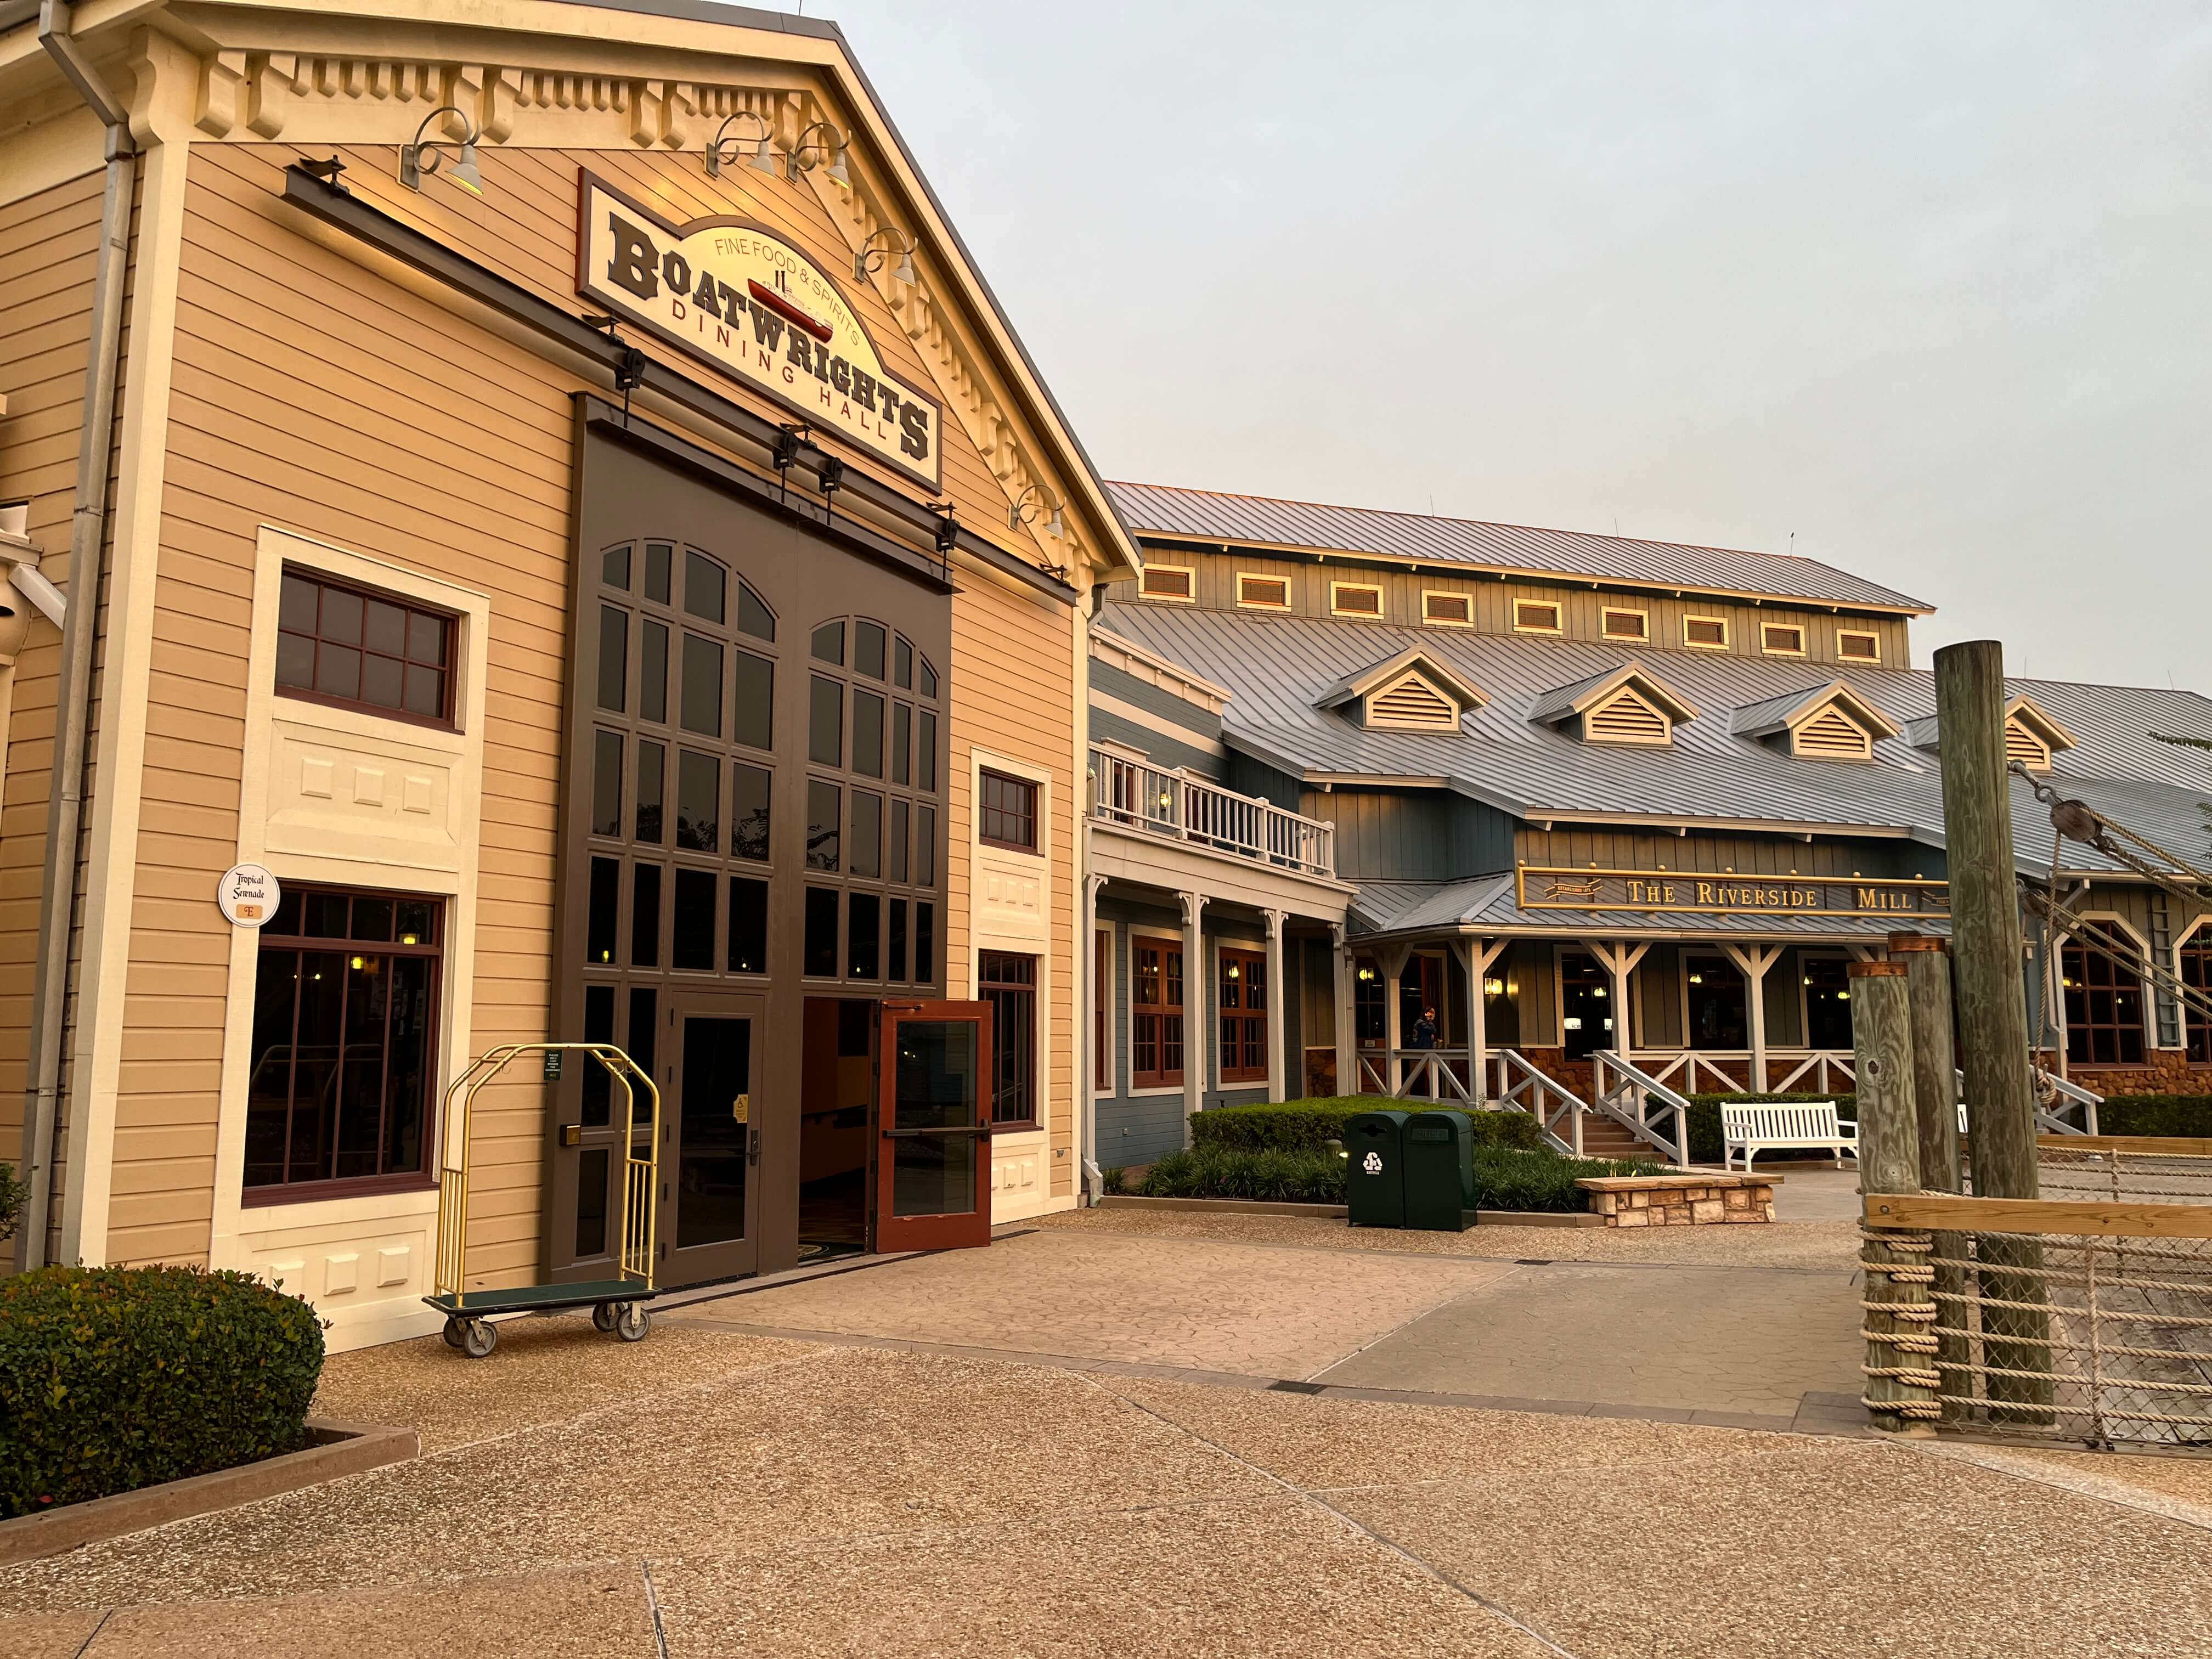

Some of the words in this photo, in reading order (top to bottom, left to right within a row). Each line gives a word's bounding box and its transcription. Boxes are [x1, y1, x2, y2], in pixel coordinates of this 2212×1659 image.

[715, 238, 750, 256] FINE
[753, 242, 796, 274] FOOD
[800, 268, 809, 286] &
[812, 279, 860, 346] SPIRITS
[608, 211, 929, 461] BOATWRIGHTS
[673, 298, 794, 384] DINING
[820, 390, 887, 440] HALL
[235, 872, 263, 885] Tropical
[233, 887, 264, 899] Serenade
[1627, 881, 1675, 902] THE
[1697, 883, 1816, 906] RIVERSIDE
[1858, 889, 1912, 909] MILL
[244, 906, 254, 917] E
